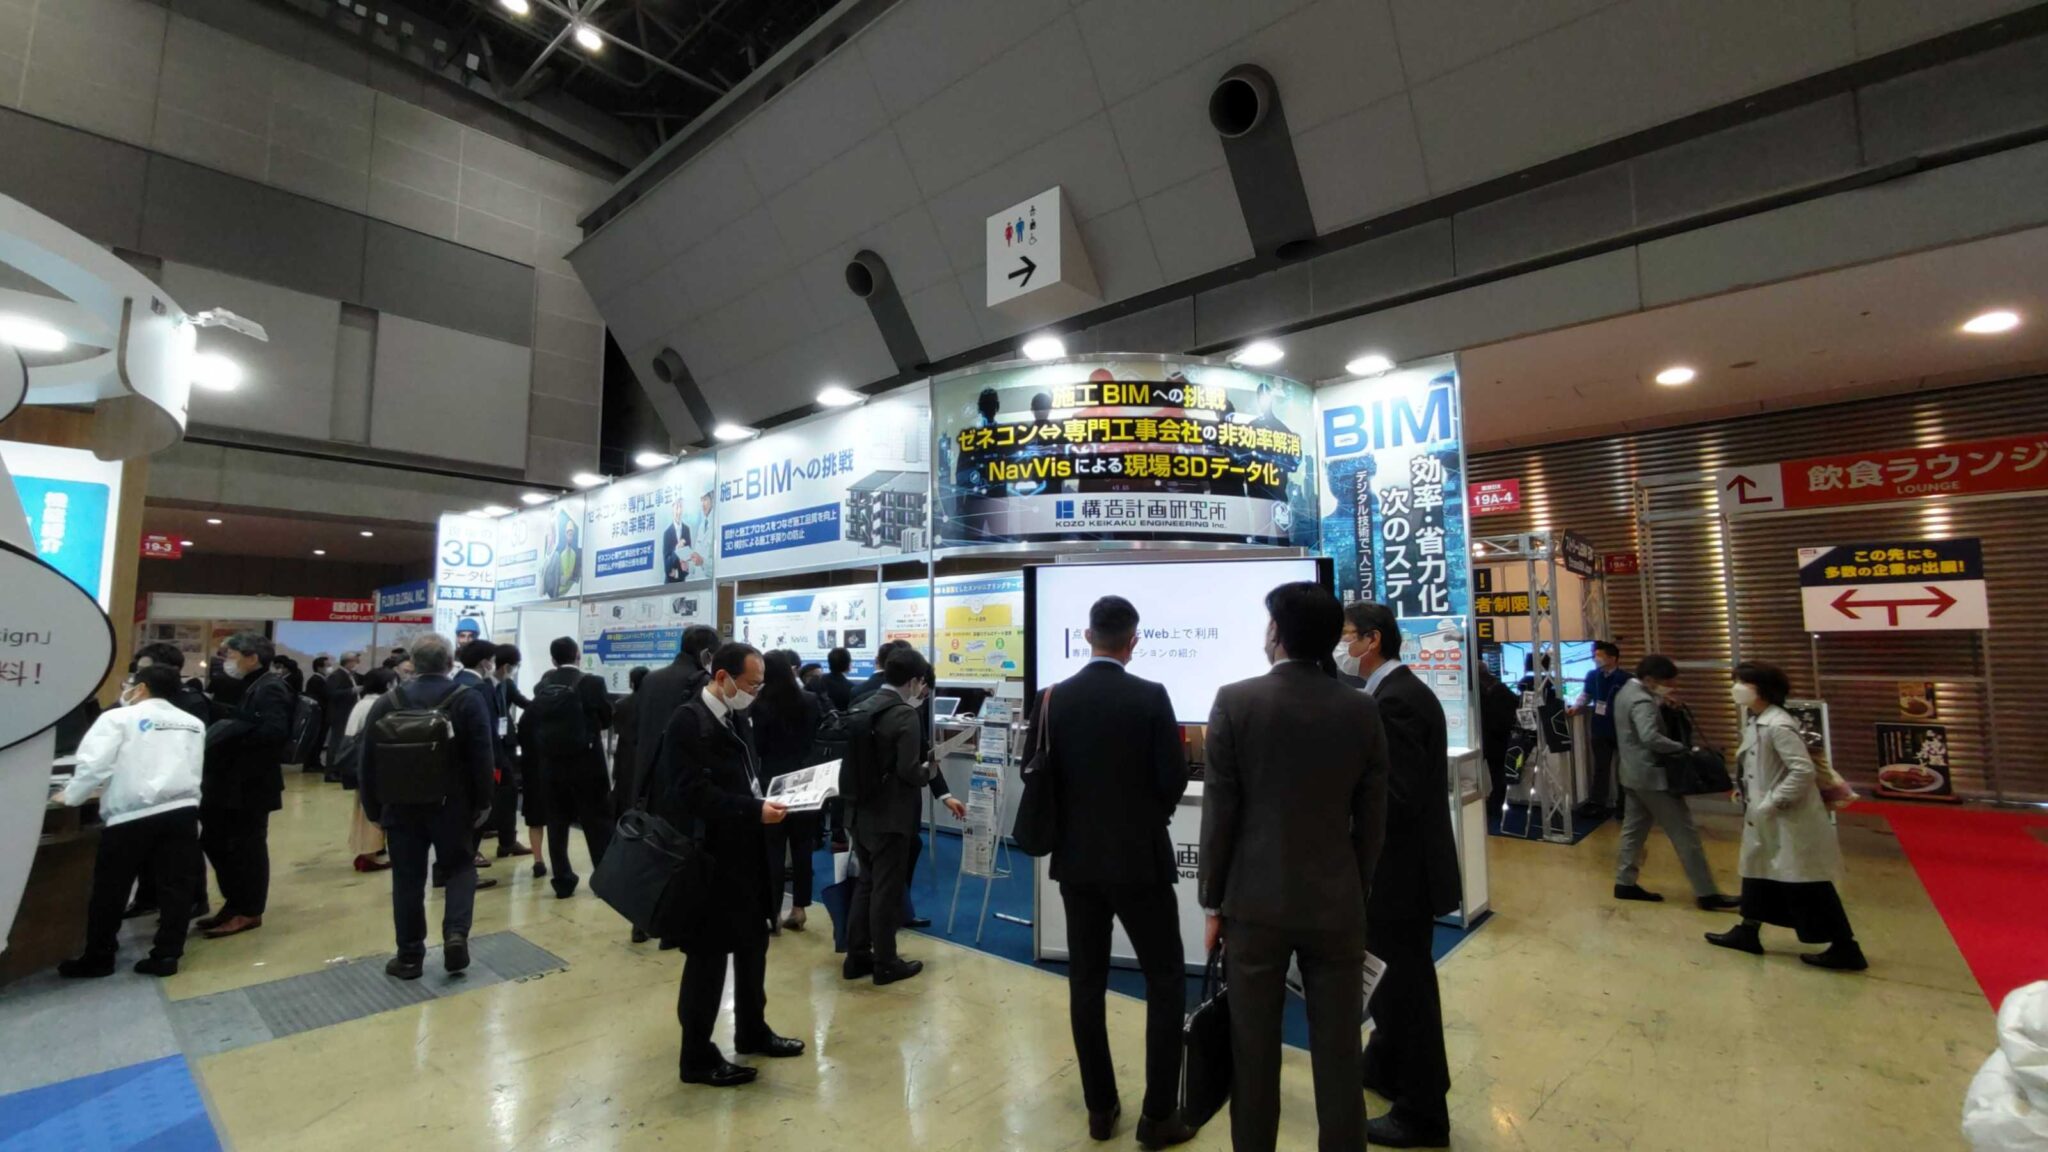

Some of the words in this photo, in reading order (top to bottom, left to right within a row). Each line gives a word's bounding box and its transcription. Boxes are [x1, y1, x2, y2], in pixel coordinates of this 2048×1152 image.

[1323, 387, 1452, 457] BIM
[1896, 479, 1961, 495] LOUNGE
[1473, 491, 1514, 506] 19A-4
[1081, 499, 1227, 521] 構造計画研究所
[1055, 519, 1086, 528] KOZO
[1088, 519, 1137, 528] KEIKAKU
[1140, 518, 1210, 528] ENGINEERING
[441, 539, 494, 568] 3D
[1854, 548, 1938, 563] この先にも
